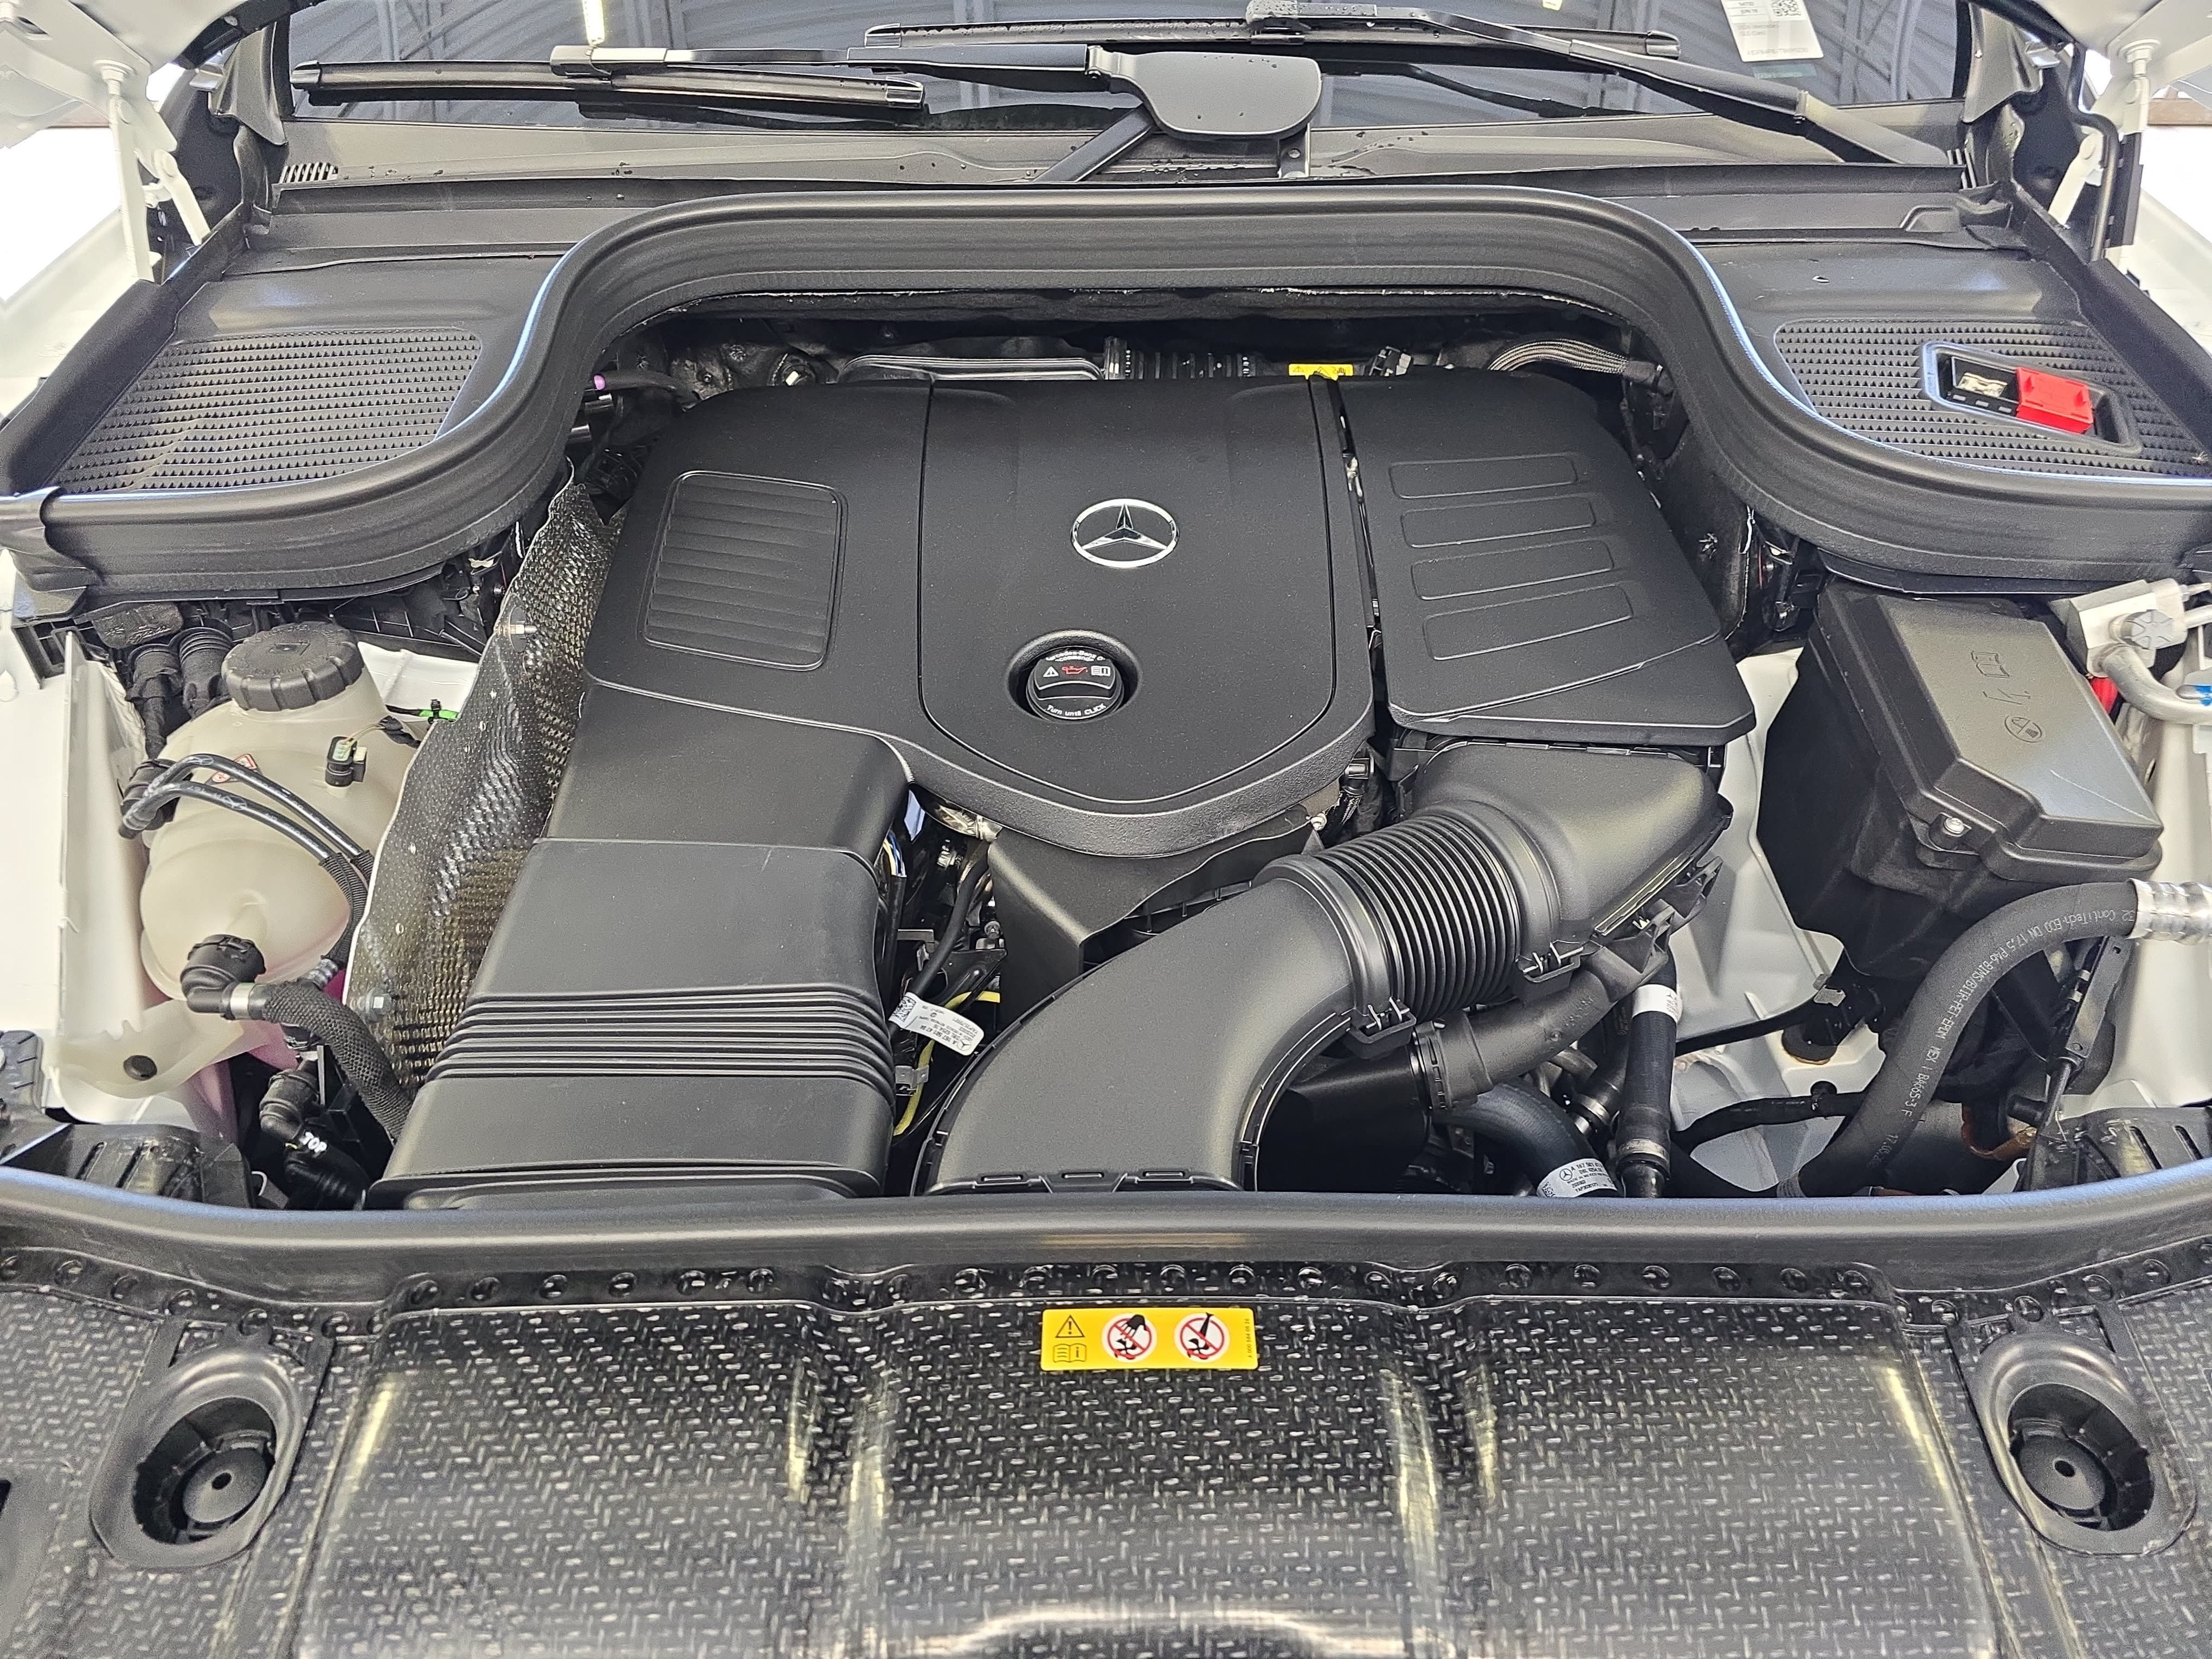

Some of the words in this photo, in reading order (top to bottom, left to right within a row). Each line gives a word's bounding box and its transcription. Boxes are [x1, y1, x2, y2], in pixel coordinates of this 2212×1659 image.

[1047, 704, 1063, 715] Turn
[1084, 703, 1106, 715] CLICK
[299, 1131, 327, 1153] TOP
